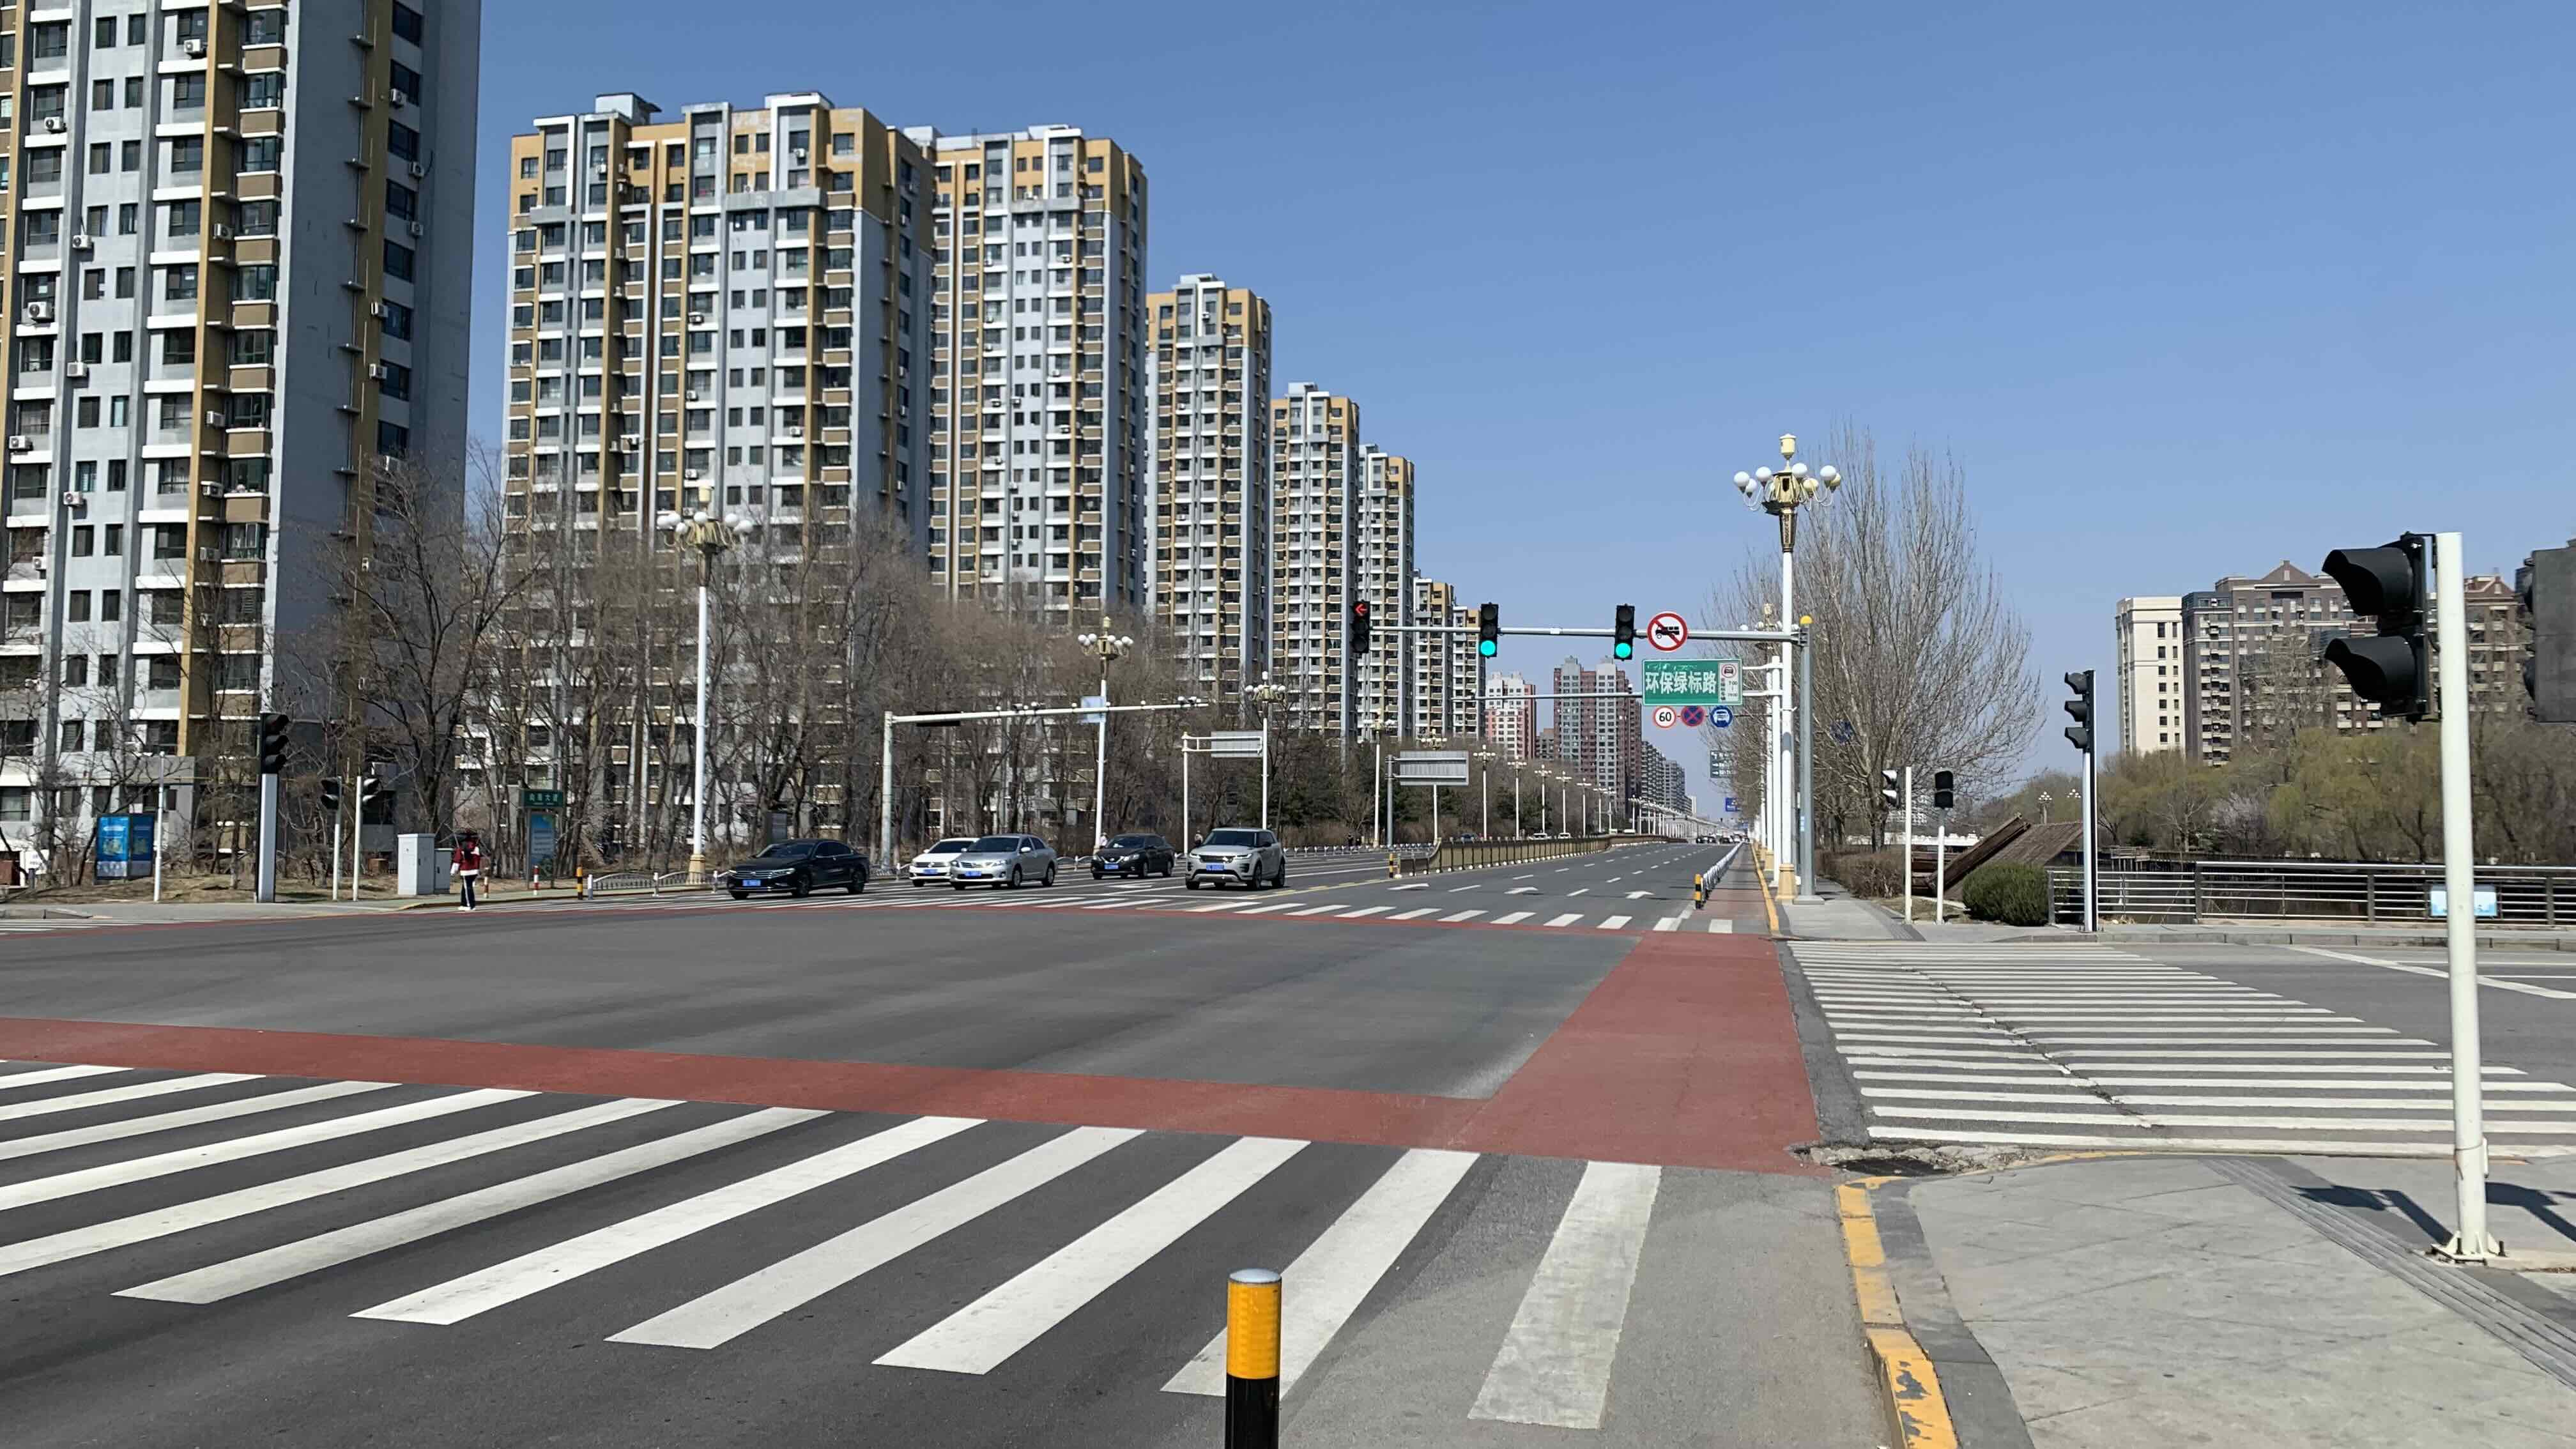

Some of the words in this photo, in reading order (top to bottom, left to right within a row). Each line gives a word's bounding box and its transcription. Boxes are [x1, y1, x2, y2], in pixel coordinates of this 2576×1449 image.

[1645, 671, 1717, 694] 环保绿标路
[1659, 712, 1671, 722] 60
